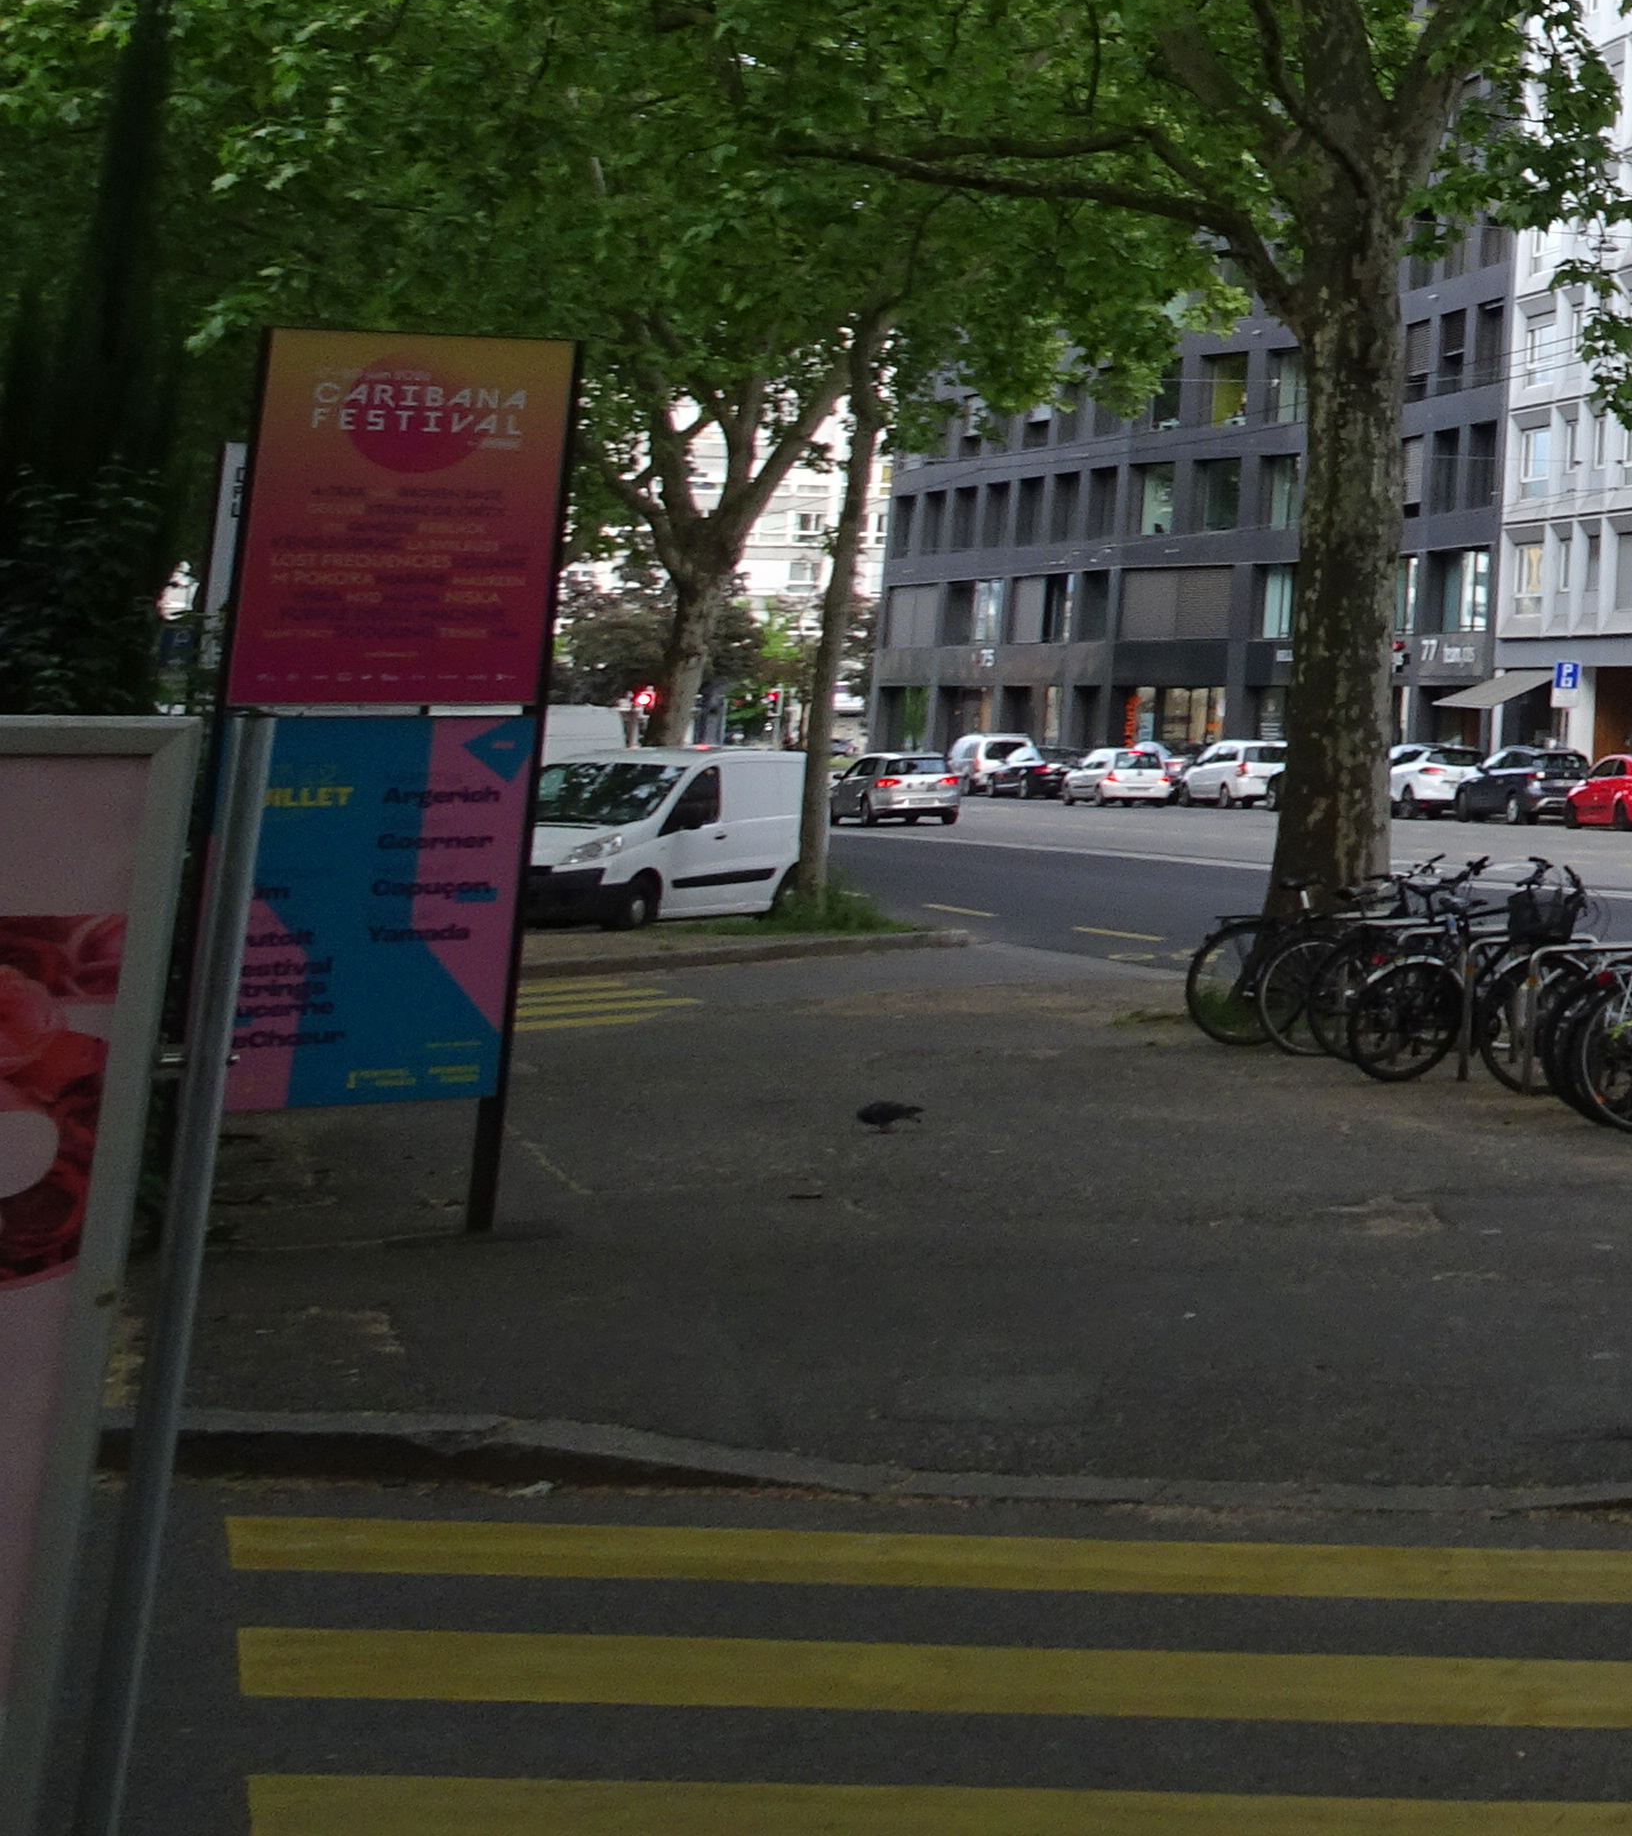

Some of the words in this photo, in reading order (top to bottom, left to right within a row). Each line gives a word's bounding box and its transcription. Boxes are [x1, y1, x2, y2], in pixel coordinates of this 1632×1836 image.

[313, 381, 529, 410] CARIBANA
[311, 407, 523, 435] FESTIVAL
[1421, 639, 1438, 662] 77
[246, 928, 314, 948] utoit
[241, 957, 333, 977] estival
[239, 980, 326, 1000] trings
[236, 1001, 334, 1019] ucerne
